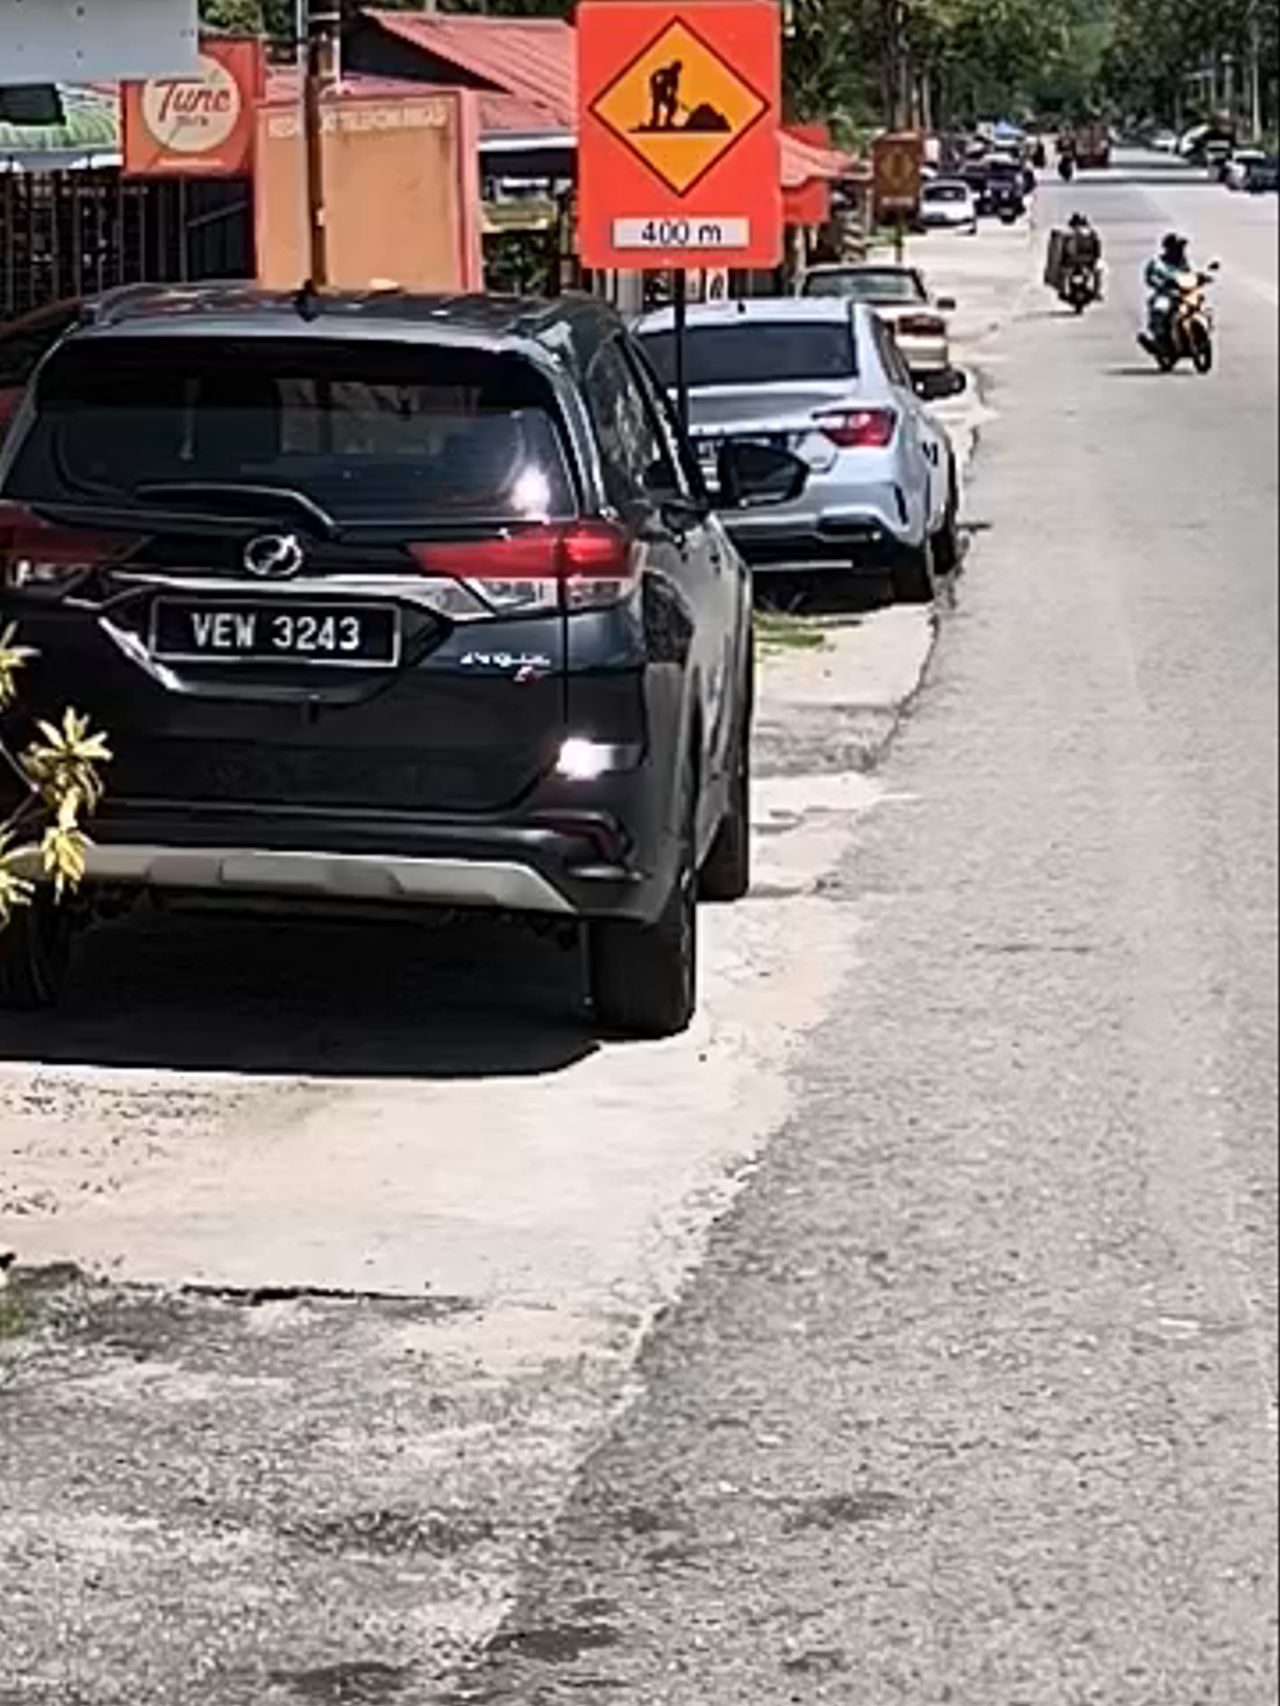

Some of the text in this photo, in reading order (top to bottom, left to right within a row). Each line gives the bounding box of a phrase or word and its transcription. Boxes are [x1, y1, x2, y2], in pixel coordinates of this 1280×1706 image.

[640, 221, 723, 244] 400 m
[192, 613, 360, 651] VEW 3243
